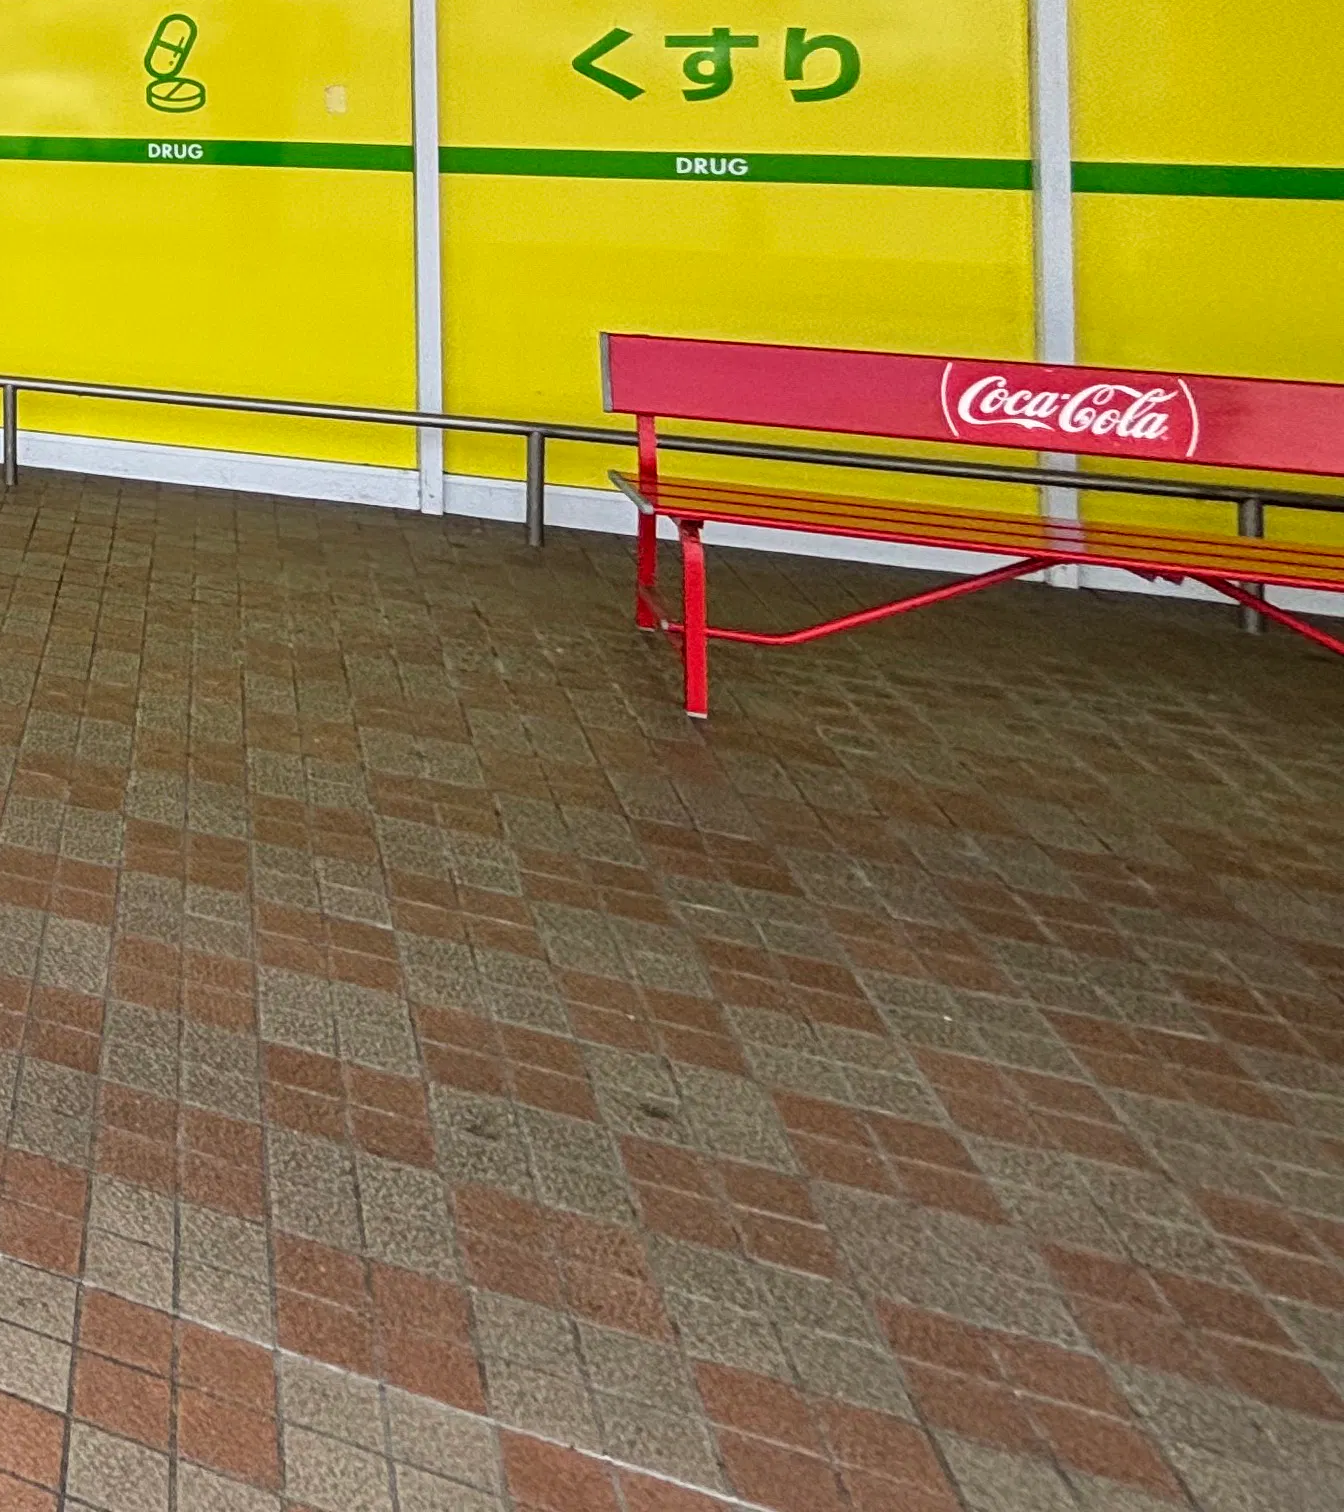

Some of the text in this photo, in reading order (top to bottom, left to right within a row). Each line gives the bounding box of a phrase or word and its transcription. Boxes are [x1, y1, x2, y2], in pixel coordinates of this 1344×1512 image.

[571, 27, 861, 103] くすり
[147, 143, 204, 159] DRUG
[675, 157, 749, 176] DRUG
[957, 375, 1179, 440] Coca-Cola
